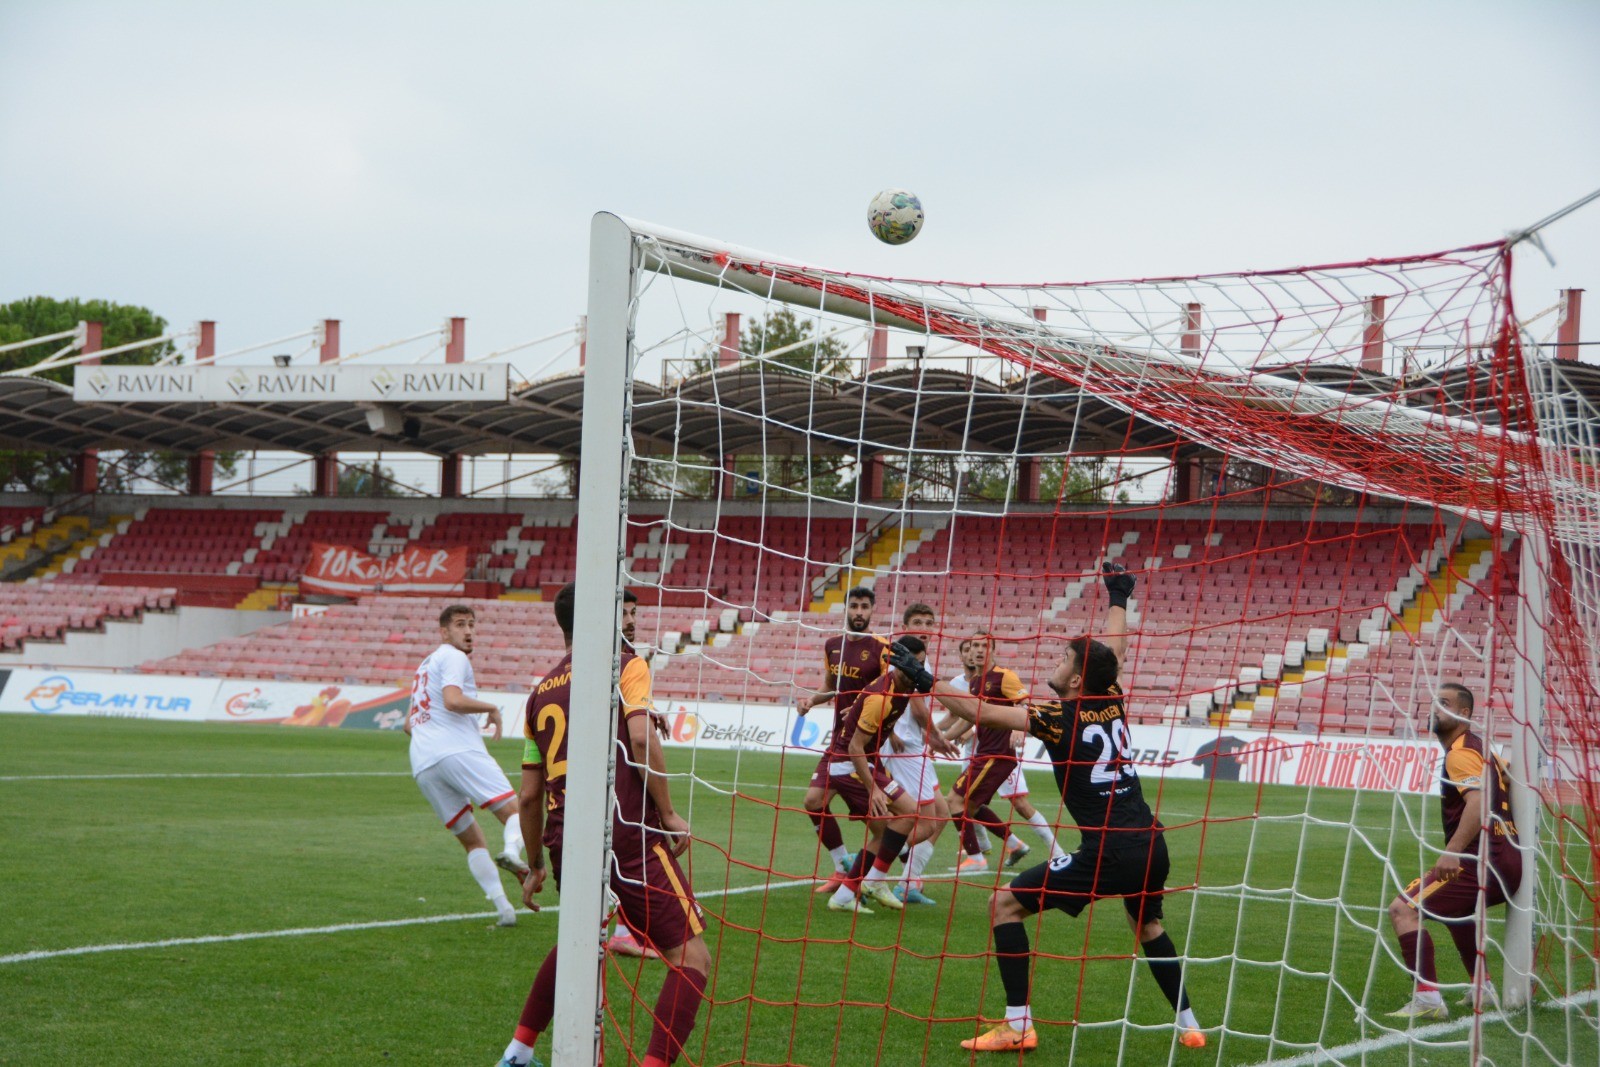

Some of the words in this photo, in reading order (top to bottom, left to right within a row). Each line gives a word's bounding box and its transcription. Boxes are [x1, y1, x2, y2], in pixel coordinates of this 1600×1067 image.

[117, 375, 194, 393] RAVINI
[257, 374, 337, 393] RAVINI
[403, 373, 485, 392] RAVINI
[144, 695, 192, 712] TUR
[701, 723, 776, 743] Bekkiler
[1082, 718, 1136, 784] 29
